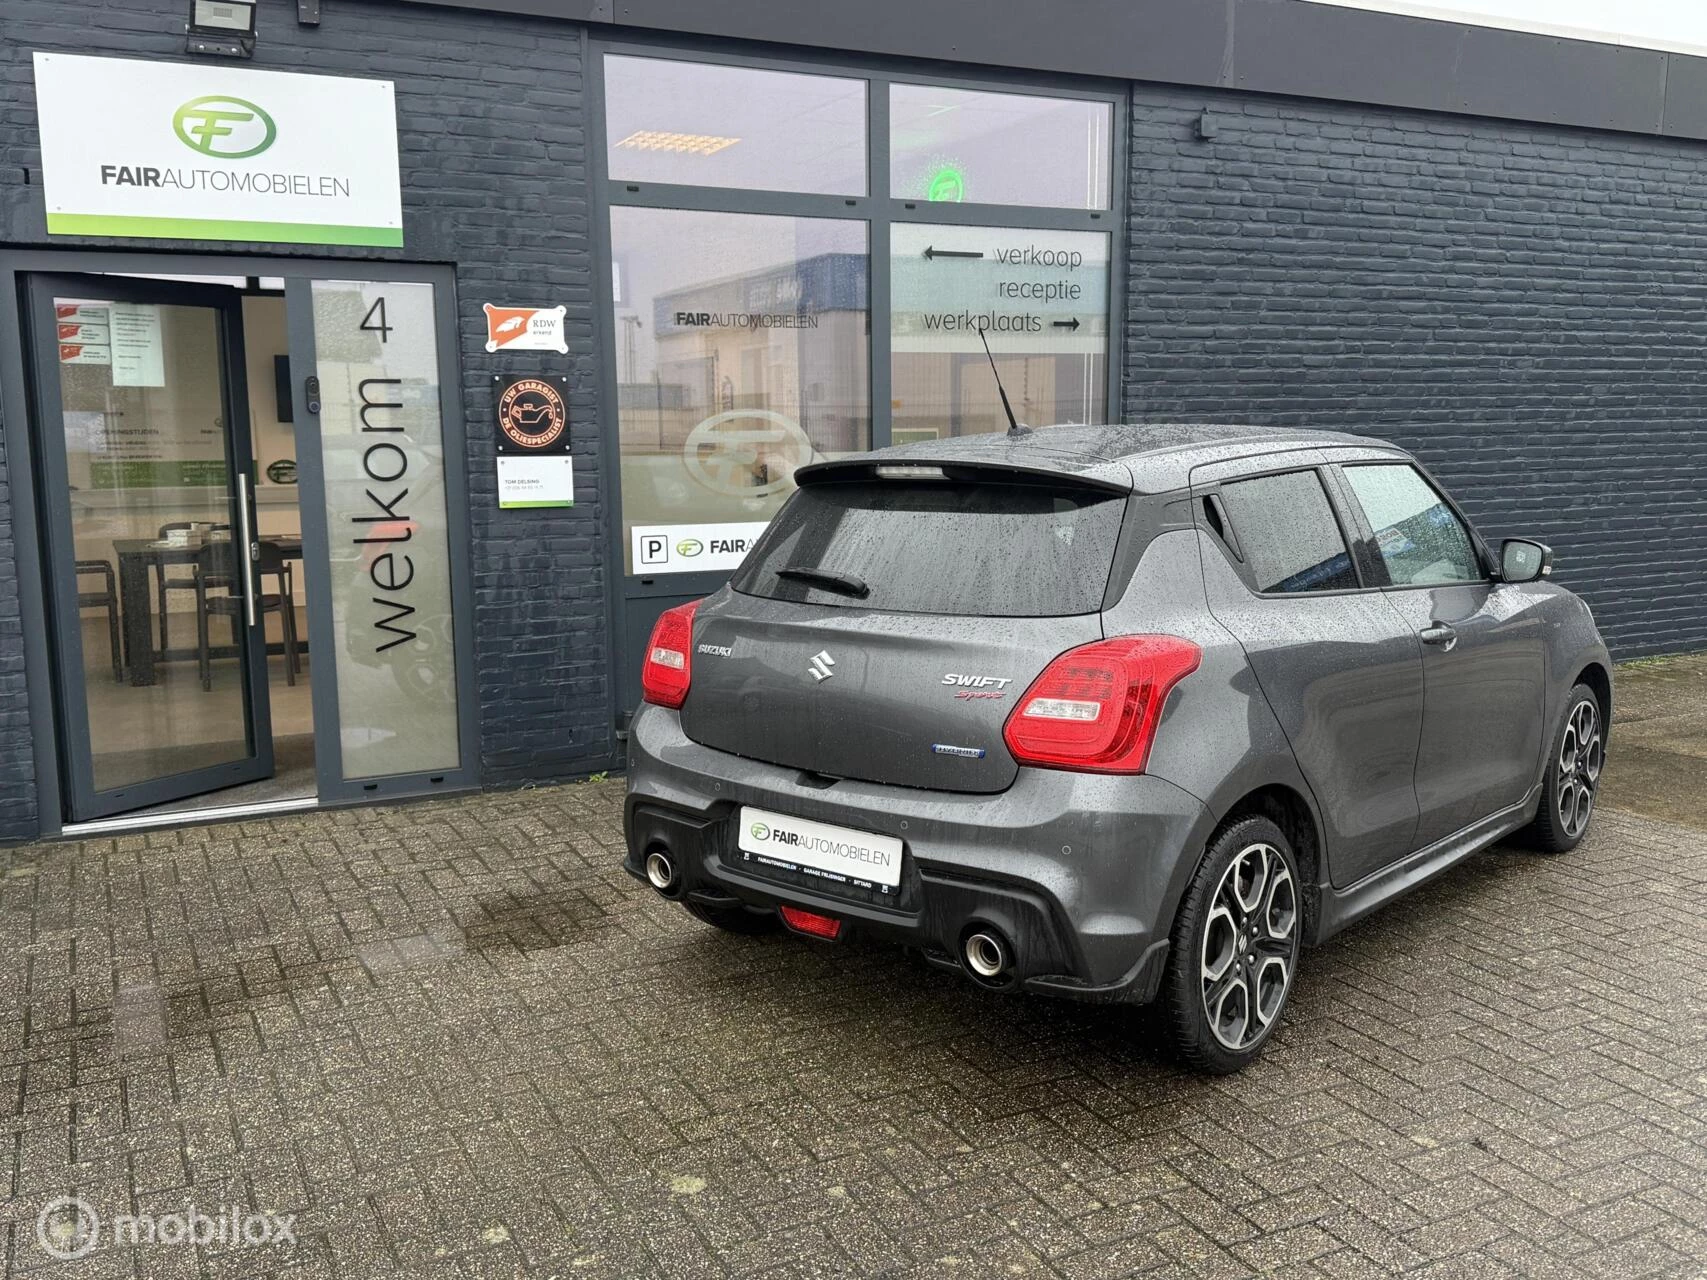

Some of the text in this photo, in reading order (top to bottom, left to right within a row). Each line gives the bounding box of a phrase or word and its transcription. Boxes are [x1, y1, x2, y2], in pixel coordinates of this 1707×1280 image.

[100, 164, 350, 197] FAIRAUTOMOBIELEN
[997, 244, 1082, 272] verkoop
[999, 279, 1081, 304] receptie
[532, 319, 557, 328] RDW
[674, 312, 819, 329] FAIRAUTOMOBIELEN
[924, 309, 1042, 335] werkplaats
[504, 382, 559, 403] UW GARAGIST
[502, 417, 562, 444] DE OLIESPECIALIST
[351, 296, 417, 653] welkom 4
[710, 538, 760, 554] FAIRA
[698, 644, 732, 657] SUZUKI
[941, 673, 1013, 690] SWIFT
[772, 829, 891, 867] FAIRAUTOMOBIELEN
[803, 867, 821, 877] GARAGE
